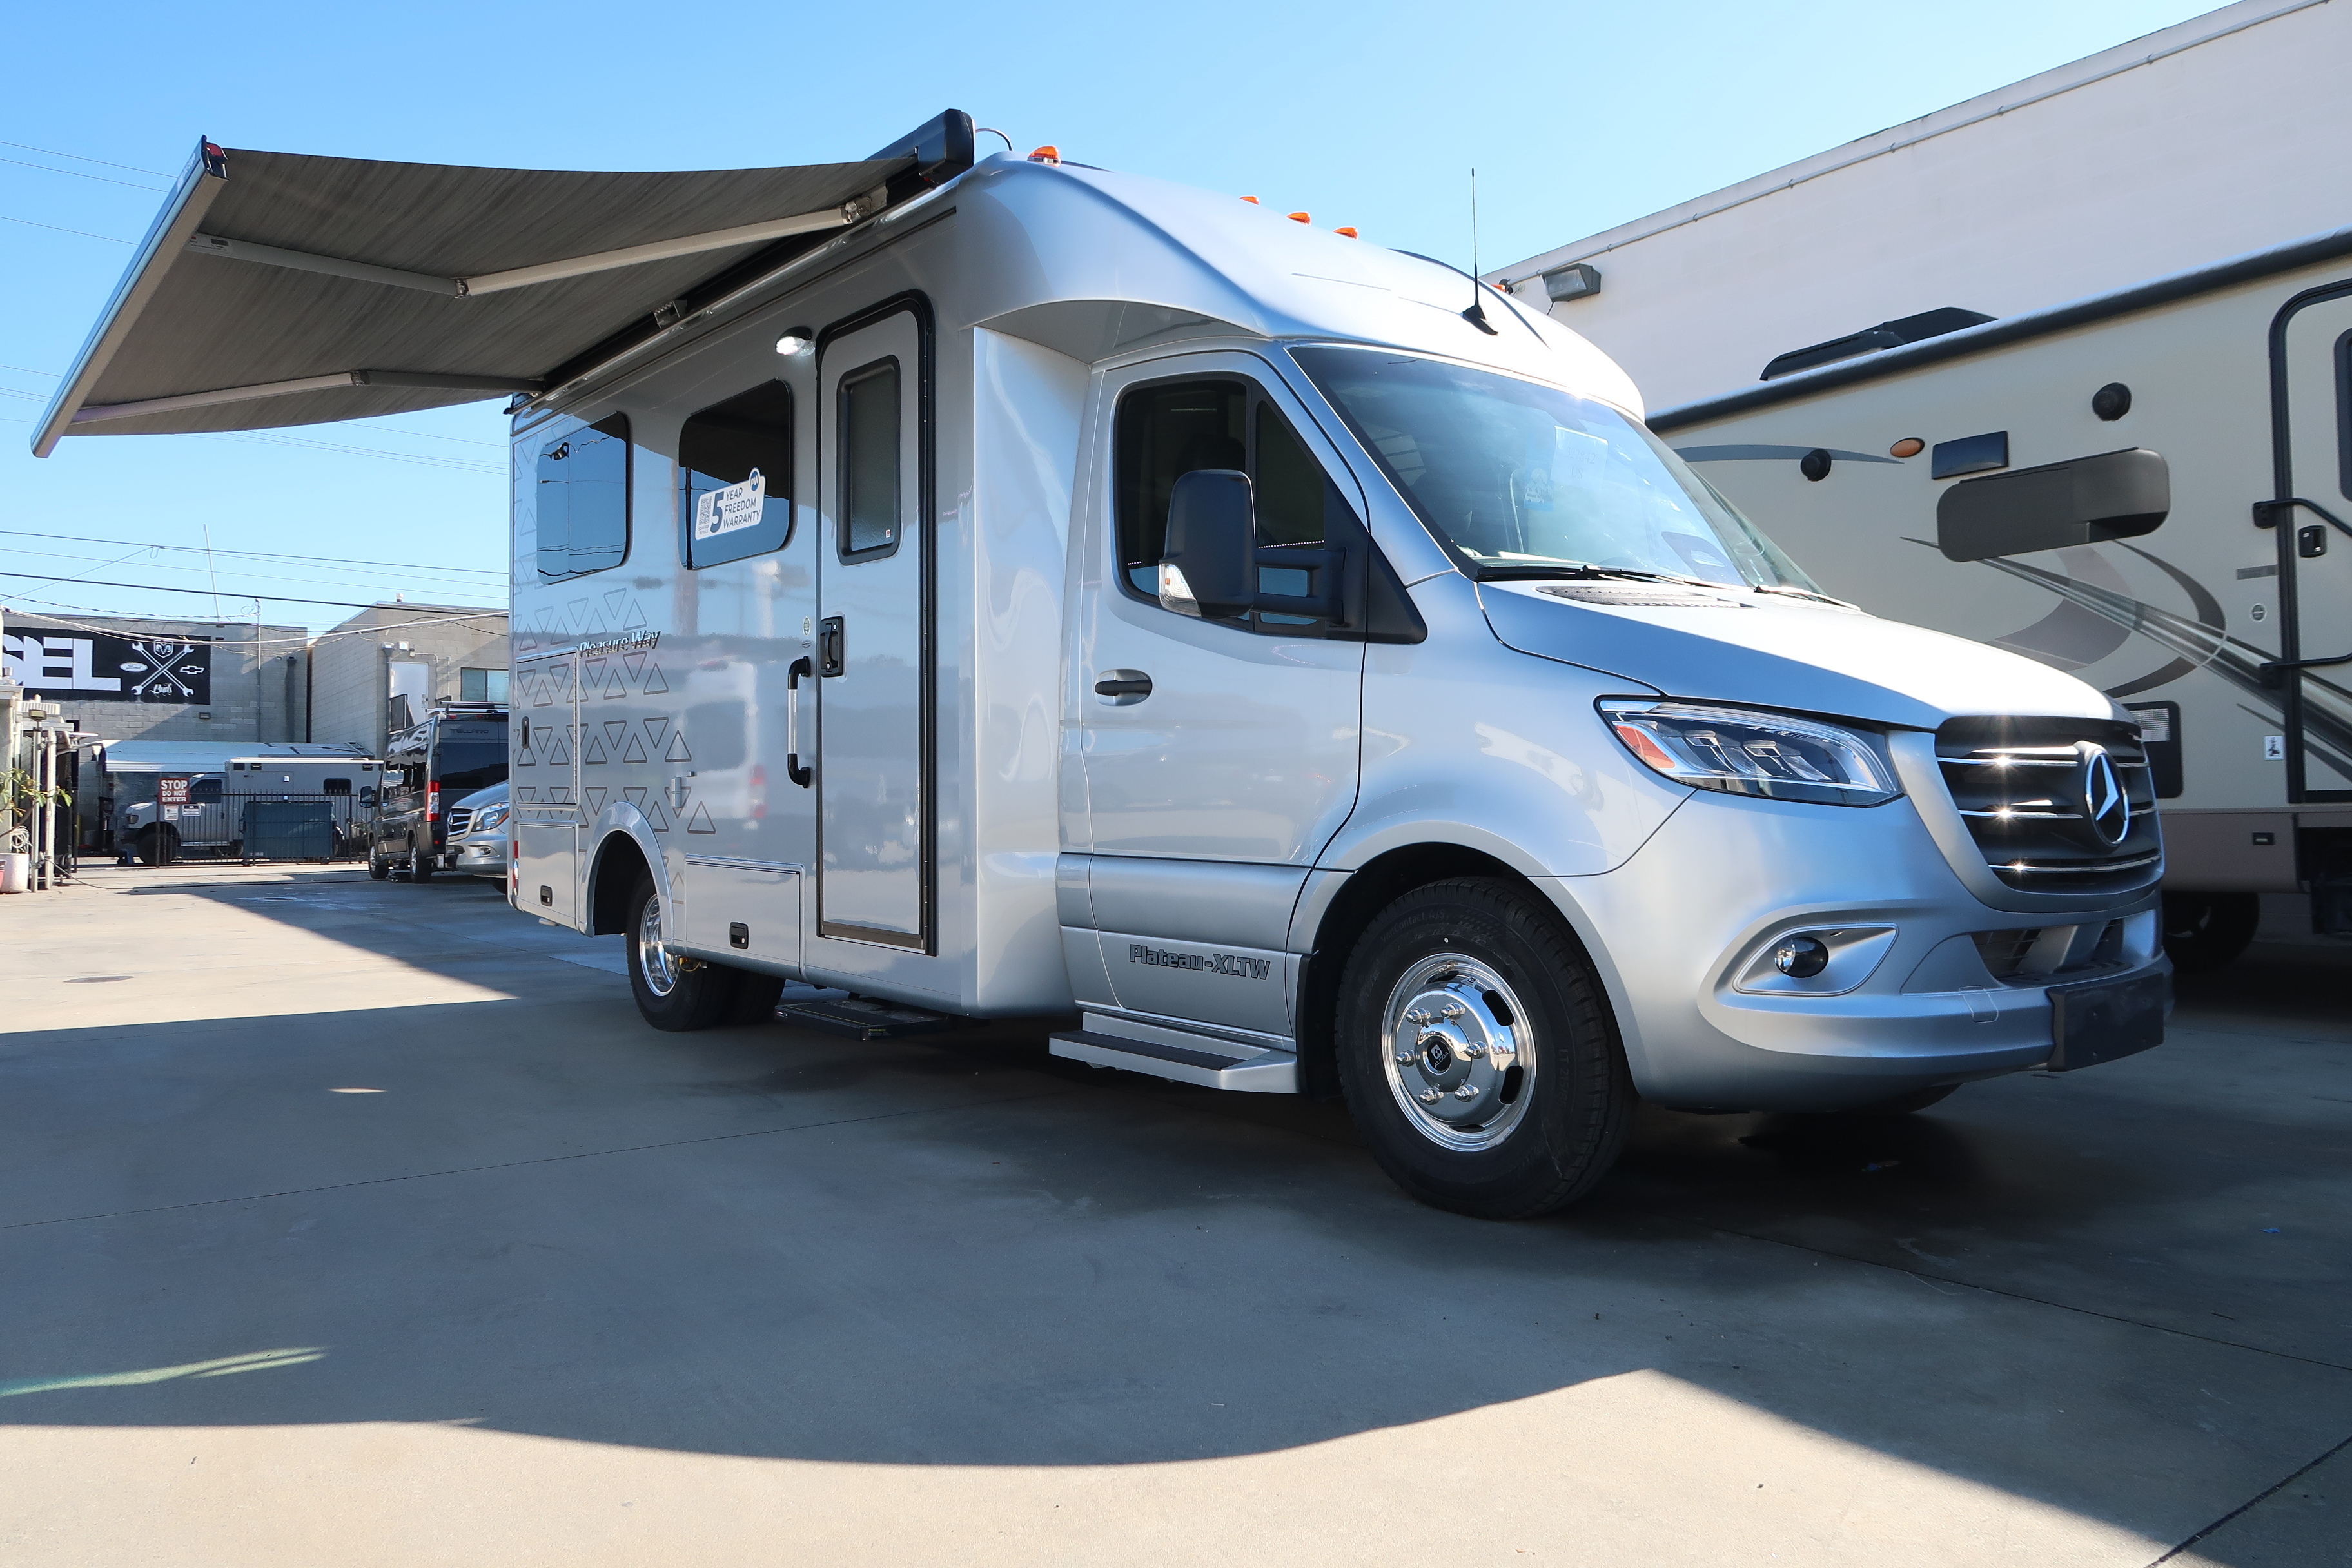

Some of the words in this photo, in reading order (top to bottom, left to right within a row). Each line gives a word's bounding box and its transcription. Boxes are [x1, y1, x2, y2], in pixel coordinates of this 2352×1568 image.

[726, 487, 743, 502] YEAR
[710, 491, 725, 533] 5
[724, 496, 757, 516] FREEDOM
[723, 509, 761, 529] WARRANTY
[161, 779, 188, 790] STOP
[1129, 944, 1271, 981] Plateau-XLTW
[1434, 1052, 1449, 1068] ALCOA
